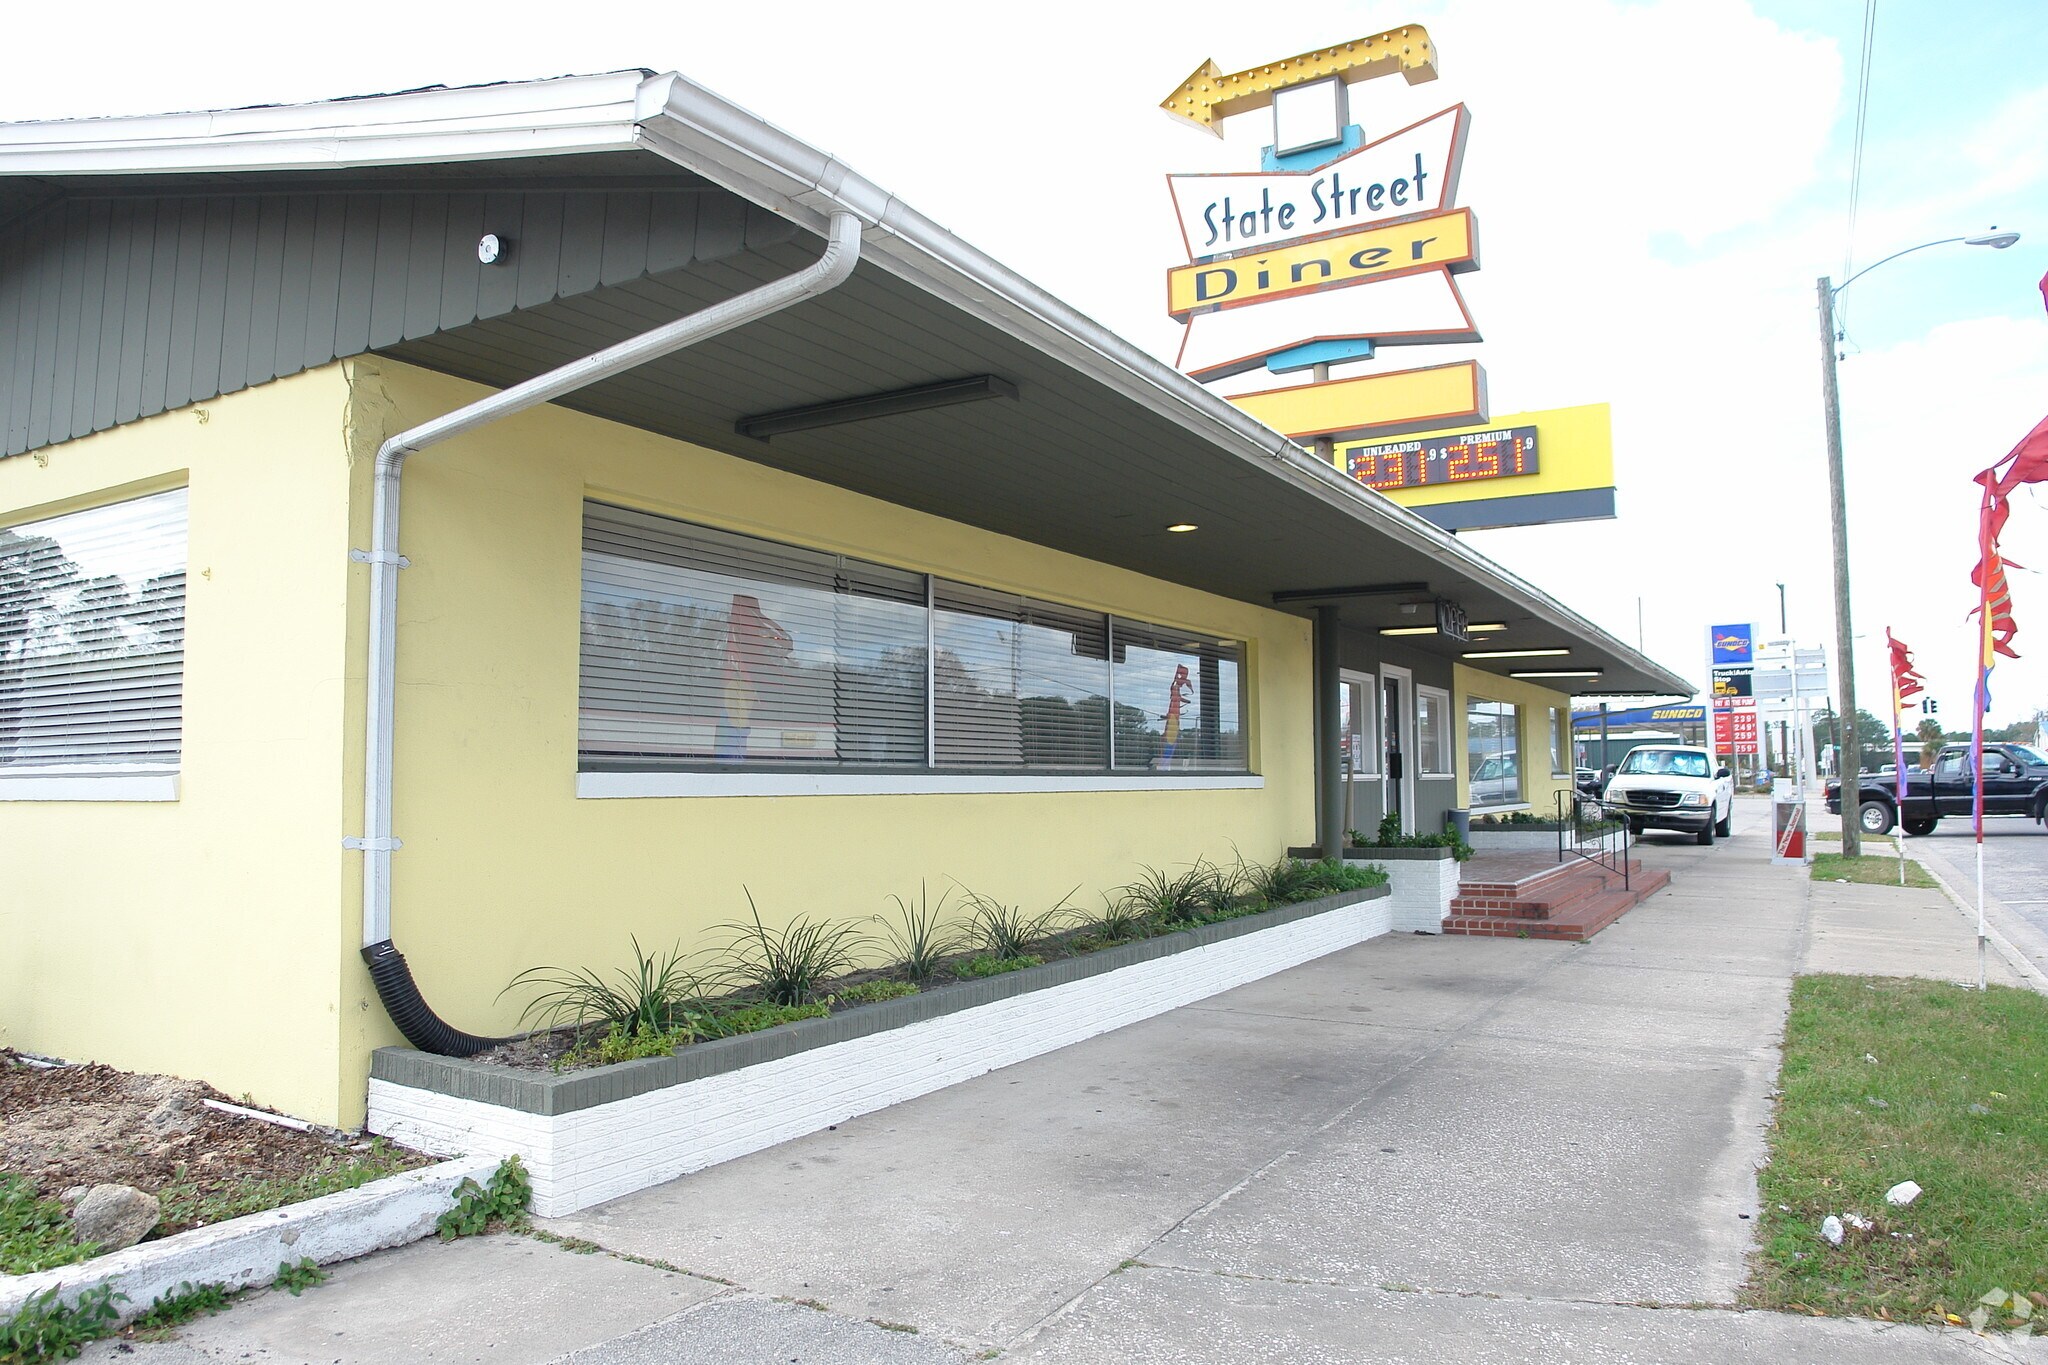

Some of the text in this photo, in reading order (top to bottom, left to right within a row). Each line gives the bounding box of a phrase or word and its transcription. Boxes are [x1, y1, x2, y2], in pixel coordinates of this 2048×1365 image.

[1204, 153, 1428, 246] State Street
[1195, 235, 1438, 302] Diner
[1460, 430, 1512, 446] PREMIUM
[1363, 441, 1421, 457] UNLEADED
[1716, 640, 1748, 648] SUNOCO
[1652, 708, 1703, 719] SUNOCO
